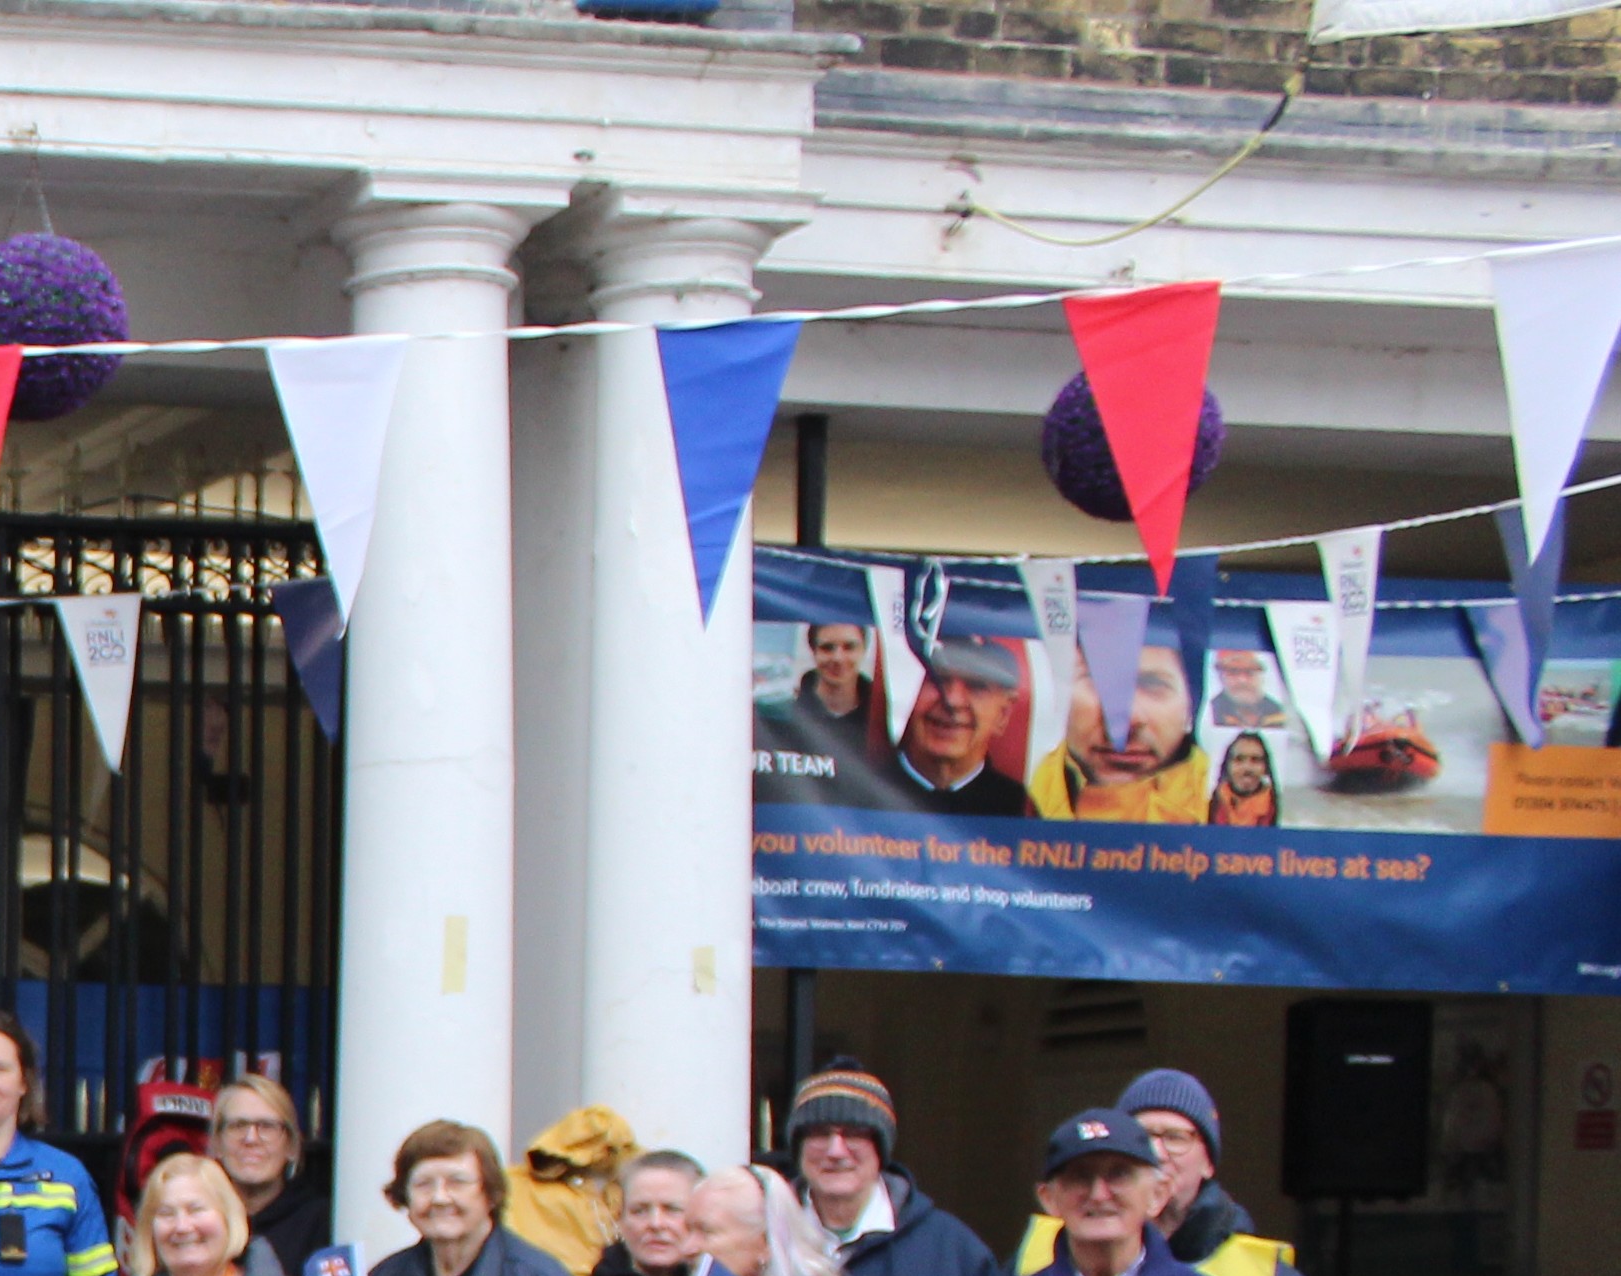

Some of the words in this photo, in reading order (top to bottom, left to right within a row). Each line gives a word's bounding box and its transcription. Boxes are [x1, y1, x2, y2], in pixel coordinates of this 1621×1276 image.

[87, 629, 125, 645] RNLI
[89, 644, 126, 661] 200
[776, 751, 836, 778] TEAM
[803, 826, 922, 862] volunteer
[926, 835, 963, 864] for
[969, 839, 1012, 866] the
[1018, 840, 1086, 870] RNLI
[1092, 844, 1145, 872] and
[1149, 845, 1209, 883] help
[1215, 852, 1273, 876] save
[1279, 849, 1337, 878] lives
[1342, 856, 1371, 879] at
[1376, 855, 1431, 882] sea?
[752, 876, 799, 898] eboat
[804, 881, 849, 900] crew,
[852, 878, 938, 902] fundraisers
[941, 884, 971, 903] and
[975, 887, 1010, 909] shop
[1012, 890, 1094, 913] volunteers
